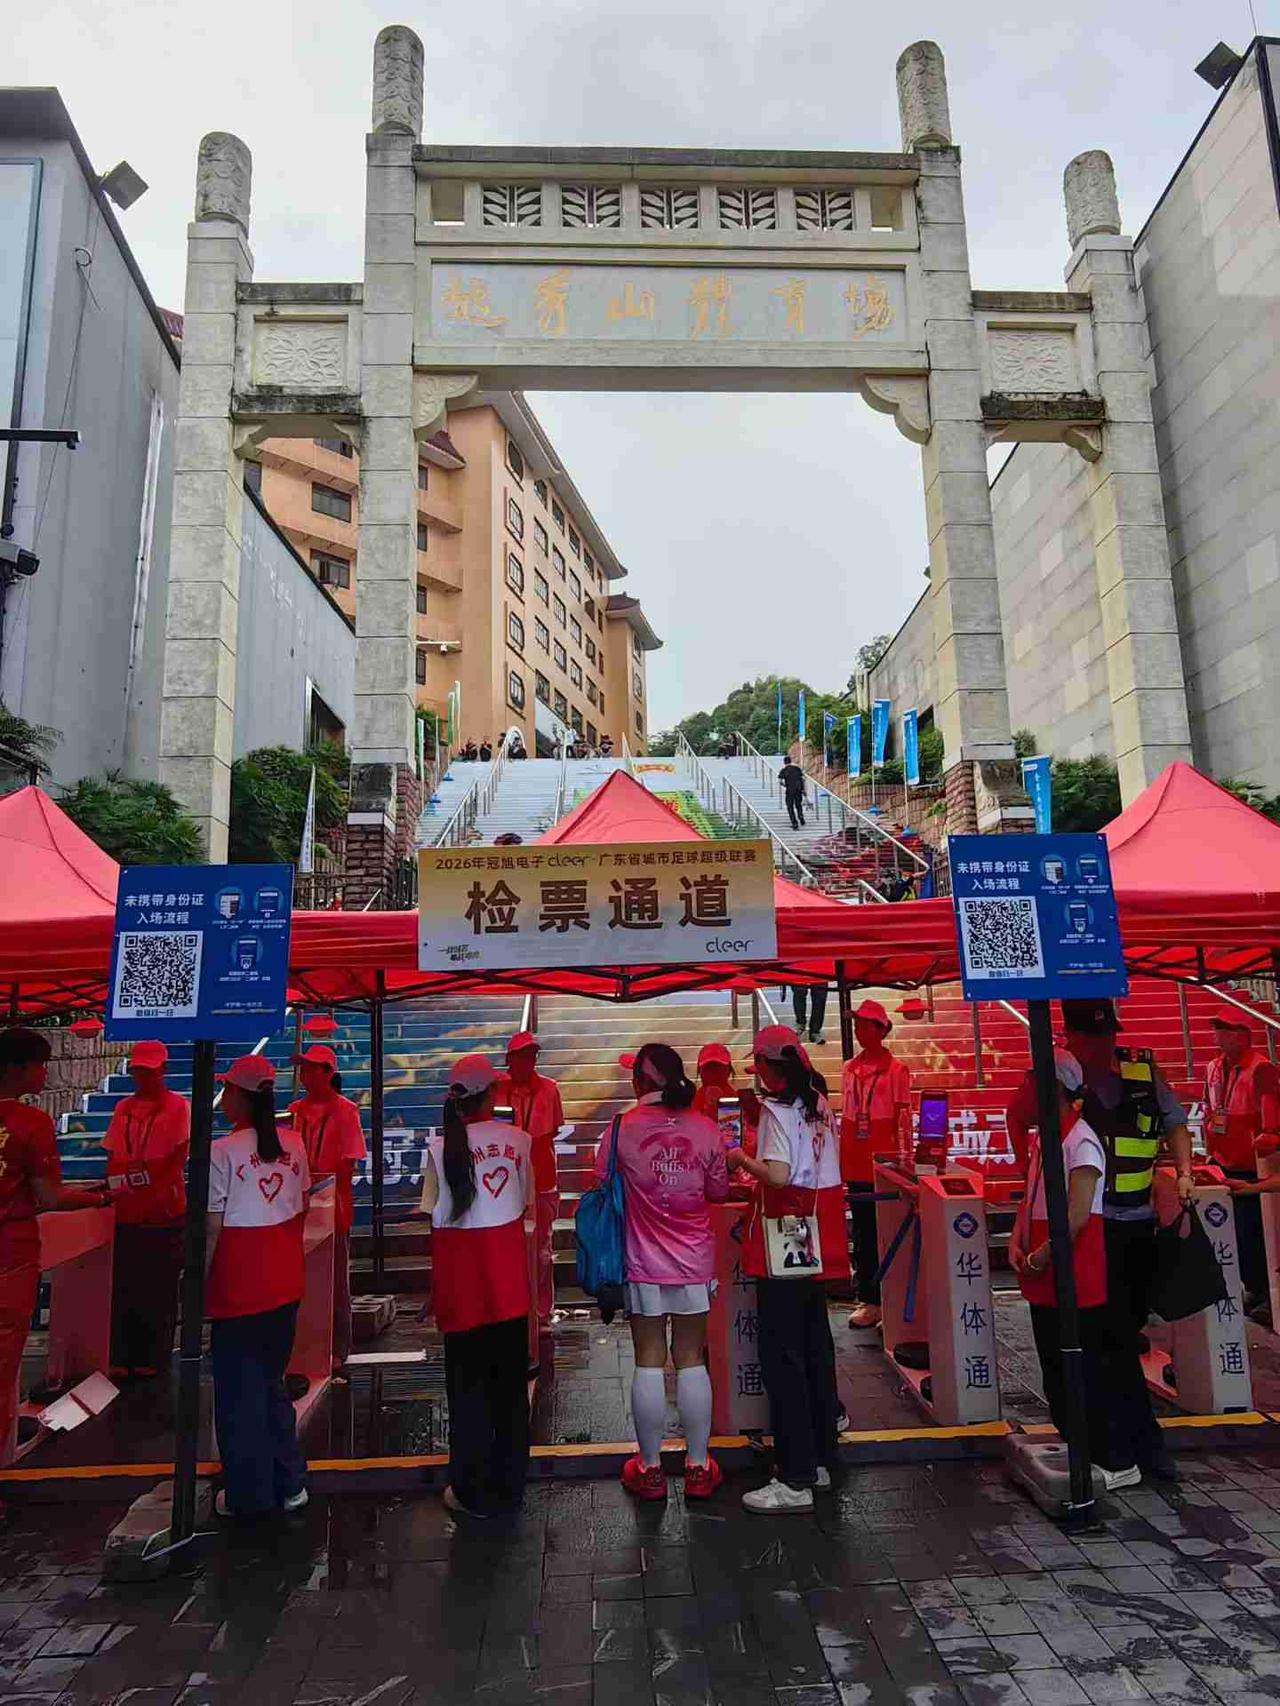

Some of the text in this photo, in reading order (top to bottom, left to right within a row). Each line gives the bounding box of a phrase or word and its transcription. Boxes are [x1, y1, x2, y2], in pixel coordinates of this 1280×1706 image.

[598, 849, 757, 868] 广东省城市足球超级联赛
[956, 860, 1031, 874] 未携带身份证
[971, 878, 1021, 891] 入场流程
[124, 893, 205, 907] 未携带身份证
[463, 874, 732, 936] 检票通道
[136, 911, 190, 925] 入场流程
[705, 938, 753, 954] cleer
[659, 1147, 680, 1160] All
[658, 1173, 680, 1186] On
[956, 1251, 993, 1389] 华体通
